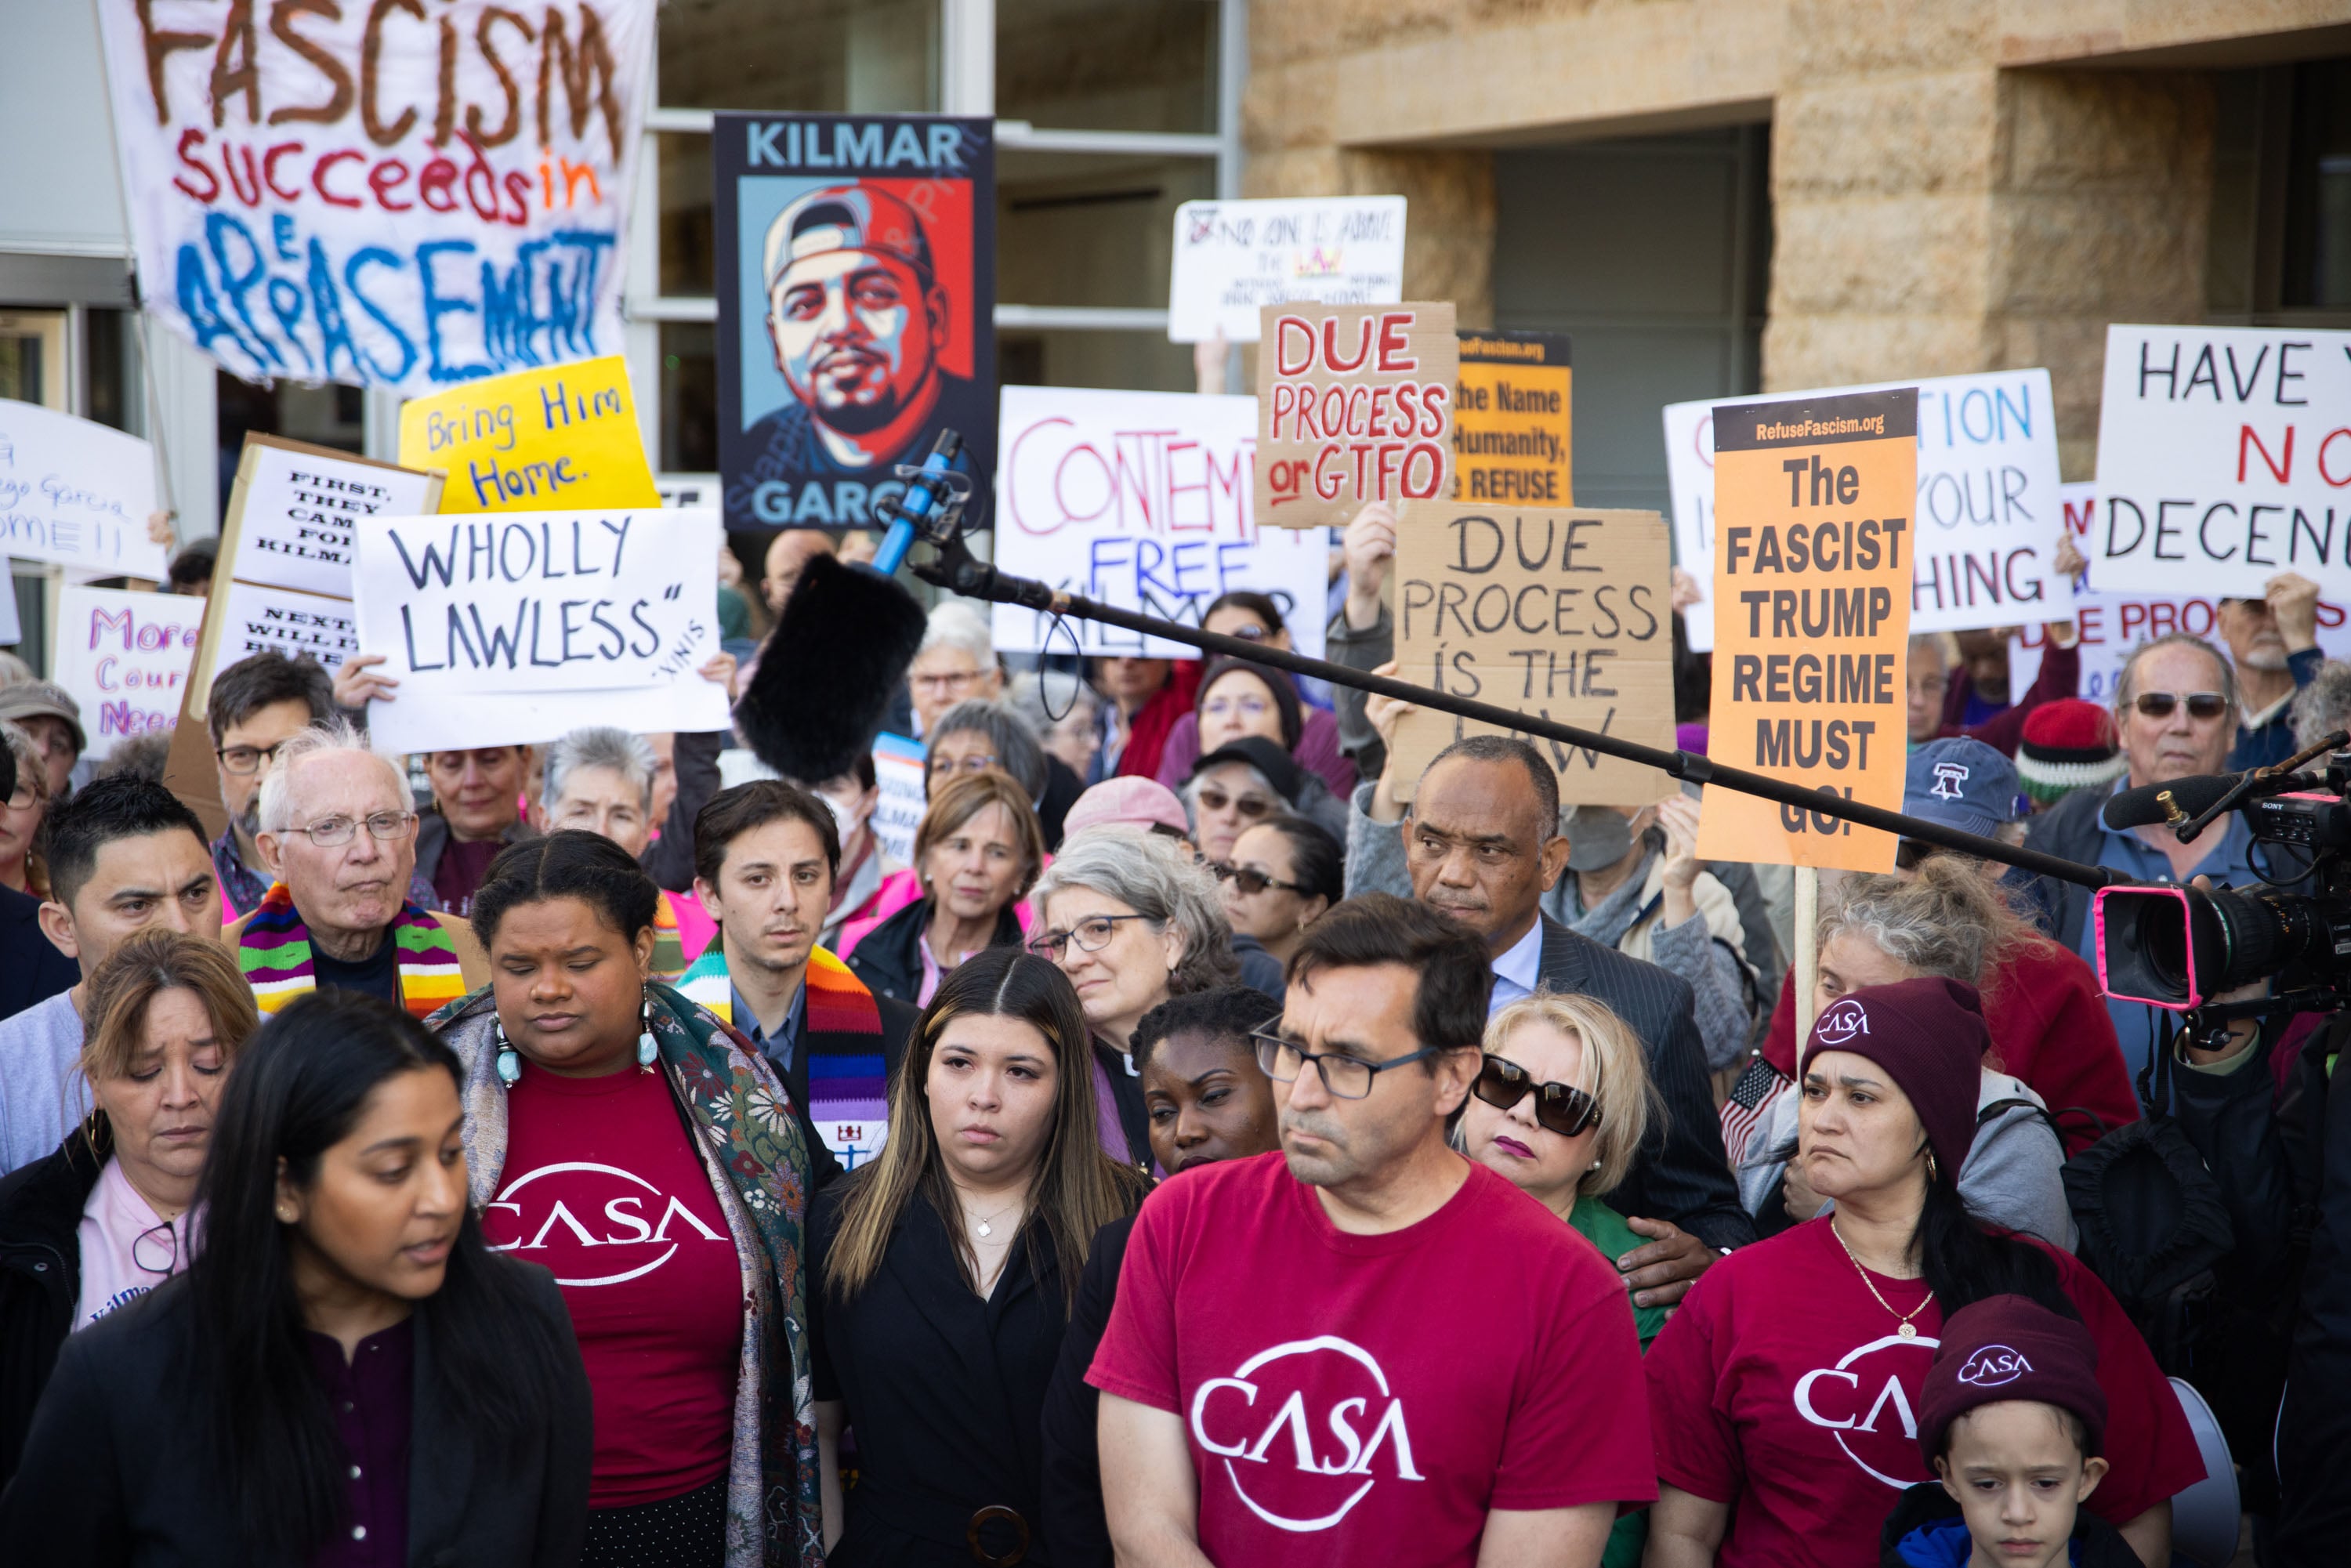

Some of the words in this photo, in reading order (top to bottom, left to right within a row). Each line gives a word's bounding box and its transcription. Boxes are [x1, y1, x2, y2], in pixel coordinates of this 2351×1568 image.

[135, 0, 622, 166] FASCISM
[746, 121, 964, 168] KILMAR
[1275, 312, 1419, 377] DUE
[1455, 380, 1488, 411] he
[1497, 380, 1562, 415] Name
[2139, 340, 2313, 406] HAVE
[427, 403, 516, 452] Bring
[540, 380, 621, 431] Him
[1270, 382, 1448, 441] PROCESS
[1756, 414, 1885, 440] RefuseFascism.org
[290, 471, 391, 502] FIRST,
[469, 454, 589, 508] Home.
[1009, 417, 1299, 545] CONTEM
[1269, 458, 1311, 506] or
[1314, 442, 1447, 501] GTFO
[1471, 468, 1559, 501] REFUSE
[1783, 455, 1860, 508] The
[288, 508, 353, 530] CAM
[294, 489, 381, 515] THEY
[751, 480, 965, 526] GARC
[388, 516, 632, 590] WHOLLY
[1447, 515, 1603, 574] DUE
[1726, 517, 1907, 574] FASCIST
[2105, 496, 2351, 567] DECEN
[1912, 546, 2045, 611] HING
[245, 622, 331, 646] WILL
[1403, 579, 1659, 641] PROCESS
[1741, 587, 1891, 639] TRUMP
[96, 655, 186, 691] Cour
[1509, 648, 1618, 699] THE
[1733, 654, 1894, 704] REGIME
[1756, 719, 1876, 770] MUST
[1817, 1012, 1871, 1034] CASA
[483, 1195, 729, 1252] CASA
[1958, 1354, 2036, 1383] CASA
[1190, 1377, 1425, 1481] CASA
[1794, 1368, 1918, 1439] CA
